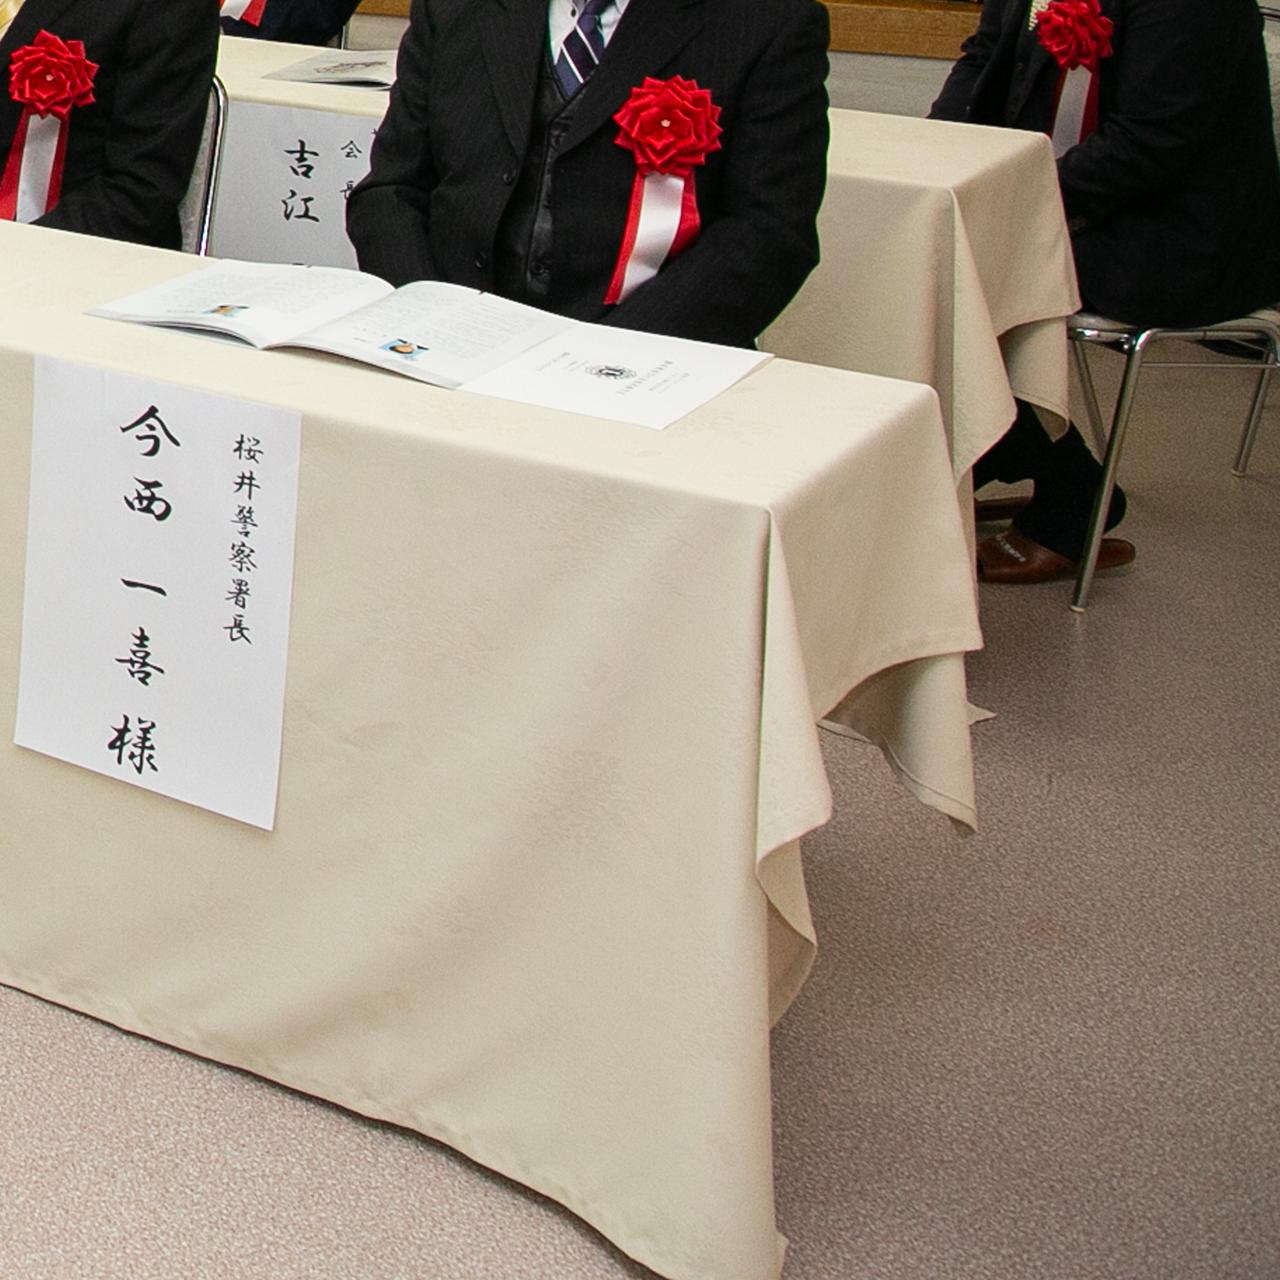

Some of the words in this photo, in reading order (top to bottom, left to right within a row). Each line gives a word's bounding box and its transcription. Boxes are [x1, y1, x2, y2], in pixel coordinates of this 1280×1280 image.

[223, 433, 265, 646] 桜井警察署長
